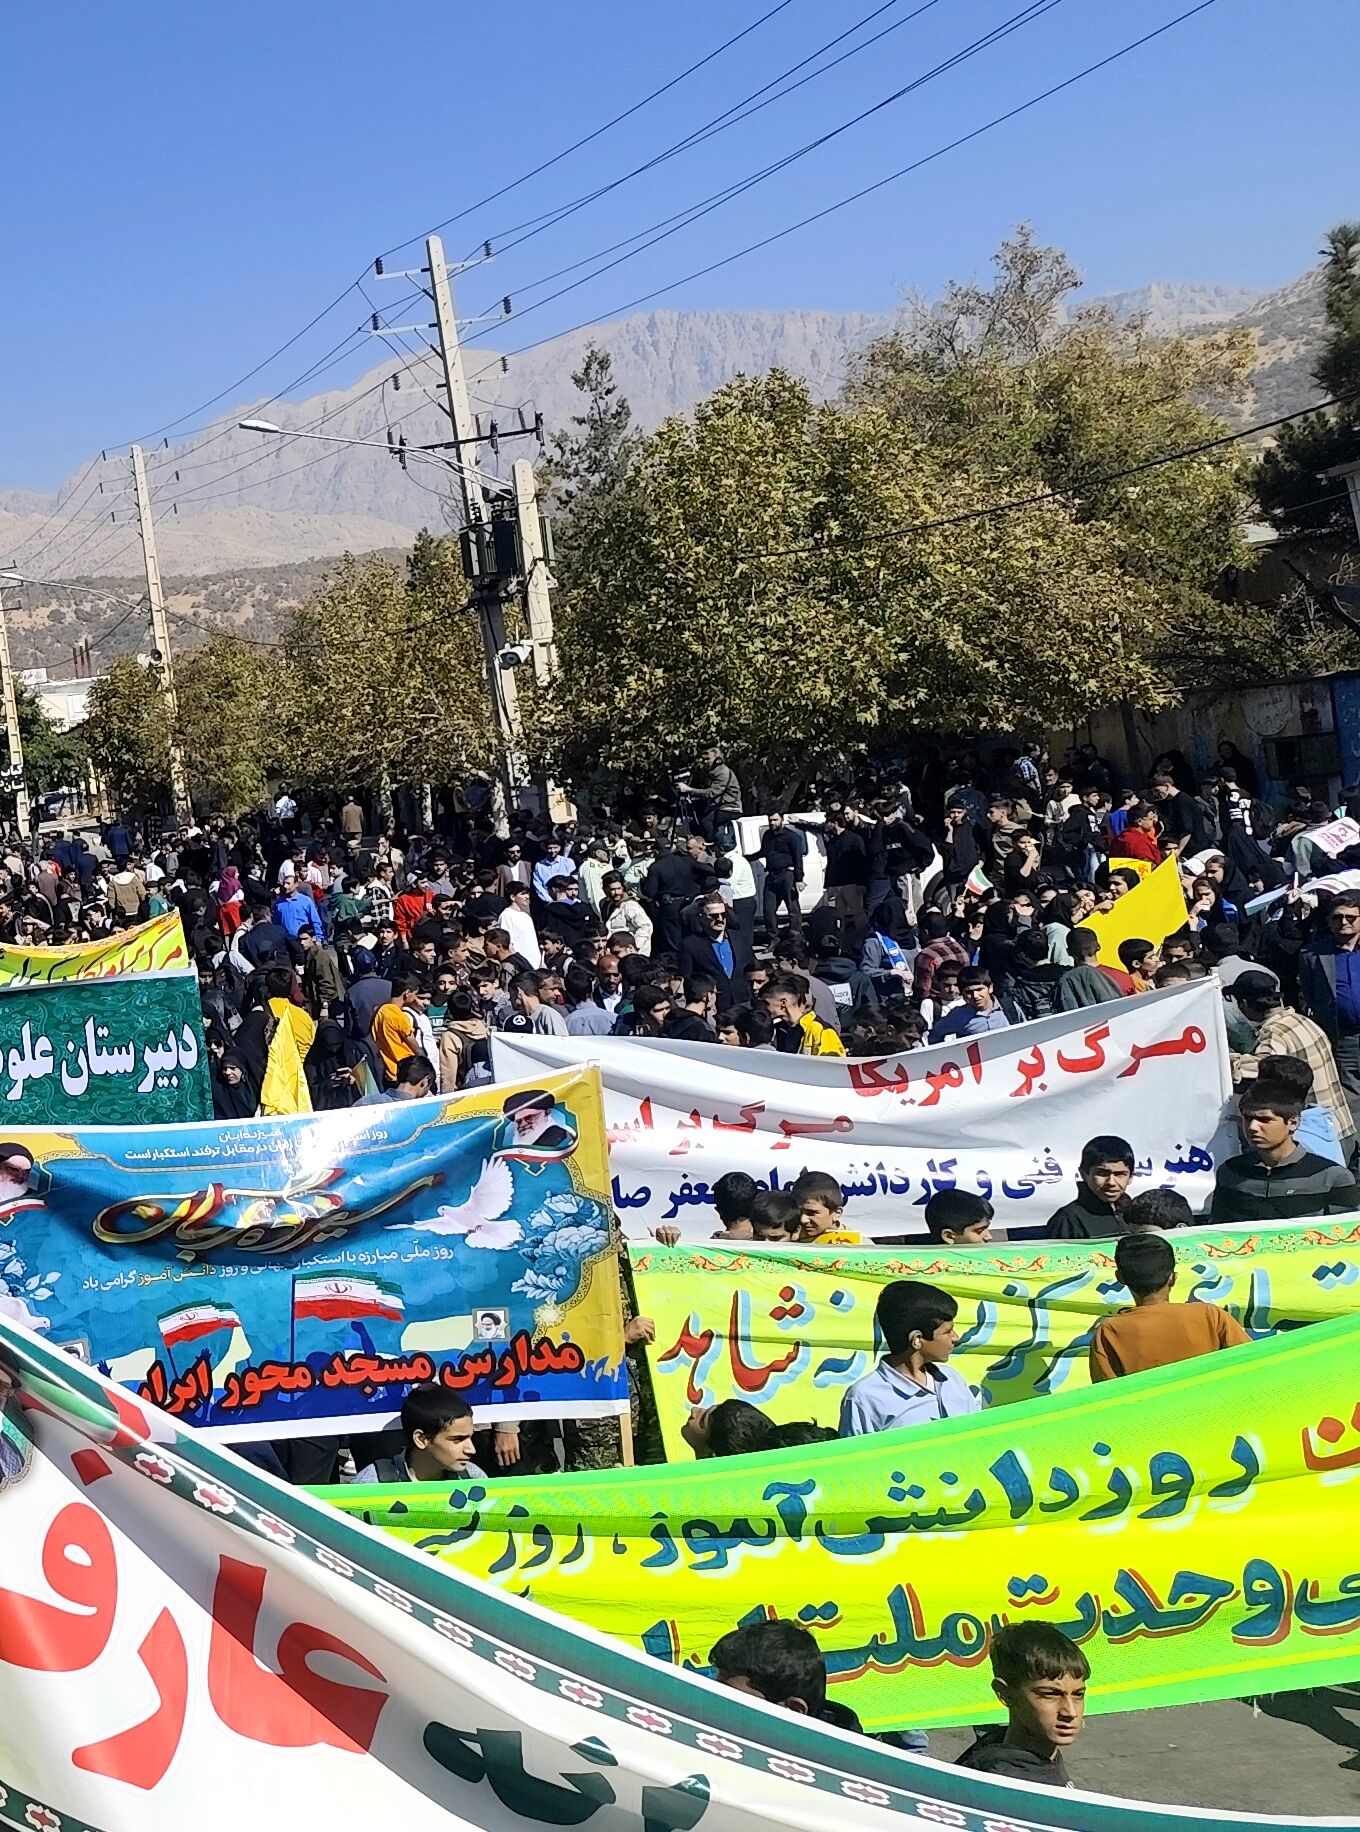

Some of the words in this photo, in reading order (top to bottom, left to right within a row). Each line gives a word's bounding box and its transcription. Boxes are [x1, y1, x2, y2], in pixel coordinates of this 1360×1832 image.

[60, 1016, 199, 1096] دبیرستان
[1009, 1044, 1047, 1098] بر
[1056, 1019, 1208, 1080] مرگ
[848, 1041, 983, 1107] امریکا
[712, 1100, 855, 1150] مرگ
[611, 1174, 652, 1209] صا
[974, 1169, 993, 1200] و
[1001, 1146, 1064, 1199] فنی
[660, 1173, 718, 1220] عفر
[176, 1263, 218, 1283] دانش
[219, 1263, 240, 1279] روز
[293, 1251, 346, 1271] استکبار
[346, 1250, 357, 1263] با
[356, 1247, 398, 1264] مبارزه
[432, 1245, 454, 1261] روز
[82, 1278, 102, 1291] باد
[101, 1269, 137, 1292] گرامی
[136, 1268, 173, 1287] آموز
[442, 1331, 582, 1389] مدارس
[657, 1287, 808, 1406] شاهد
[222, 1360, 313, 1408] محور
[322, 1350, 432, 1395] مسجد
[1080, 1435, 1260, 1521] روز
[639, 1478, 817, 1571] آموز
[816, 1448, 1080, 1556] دانش
[488, 1504, 584, 1574] روز
